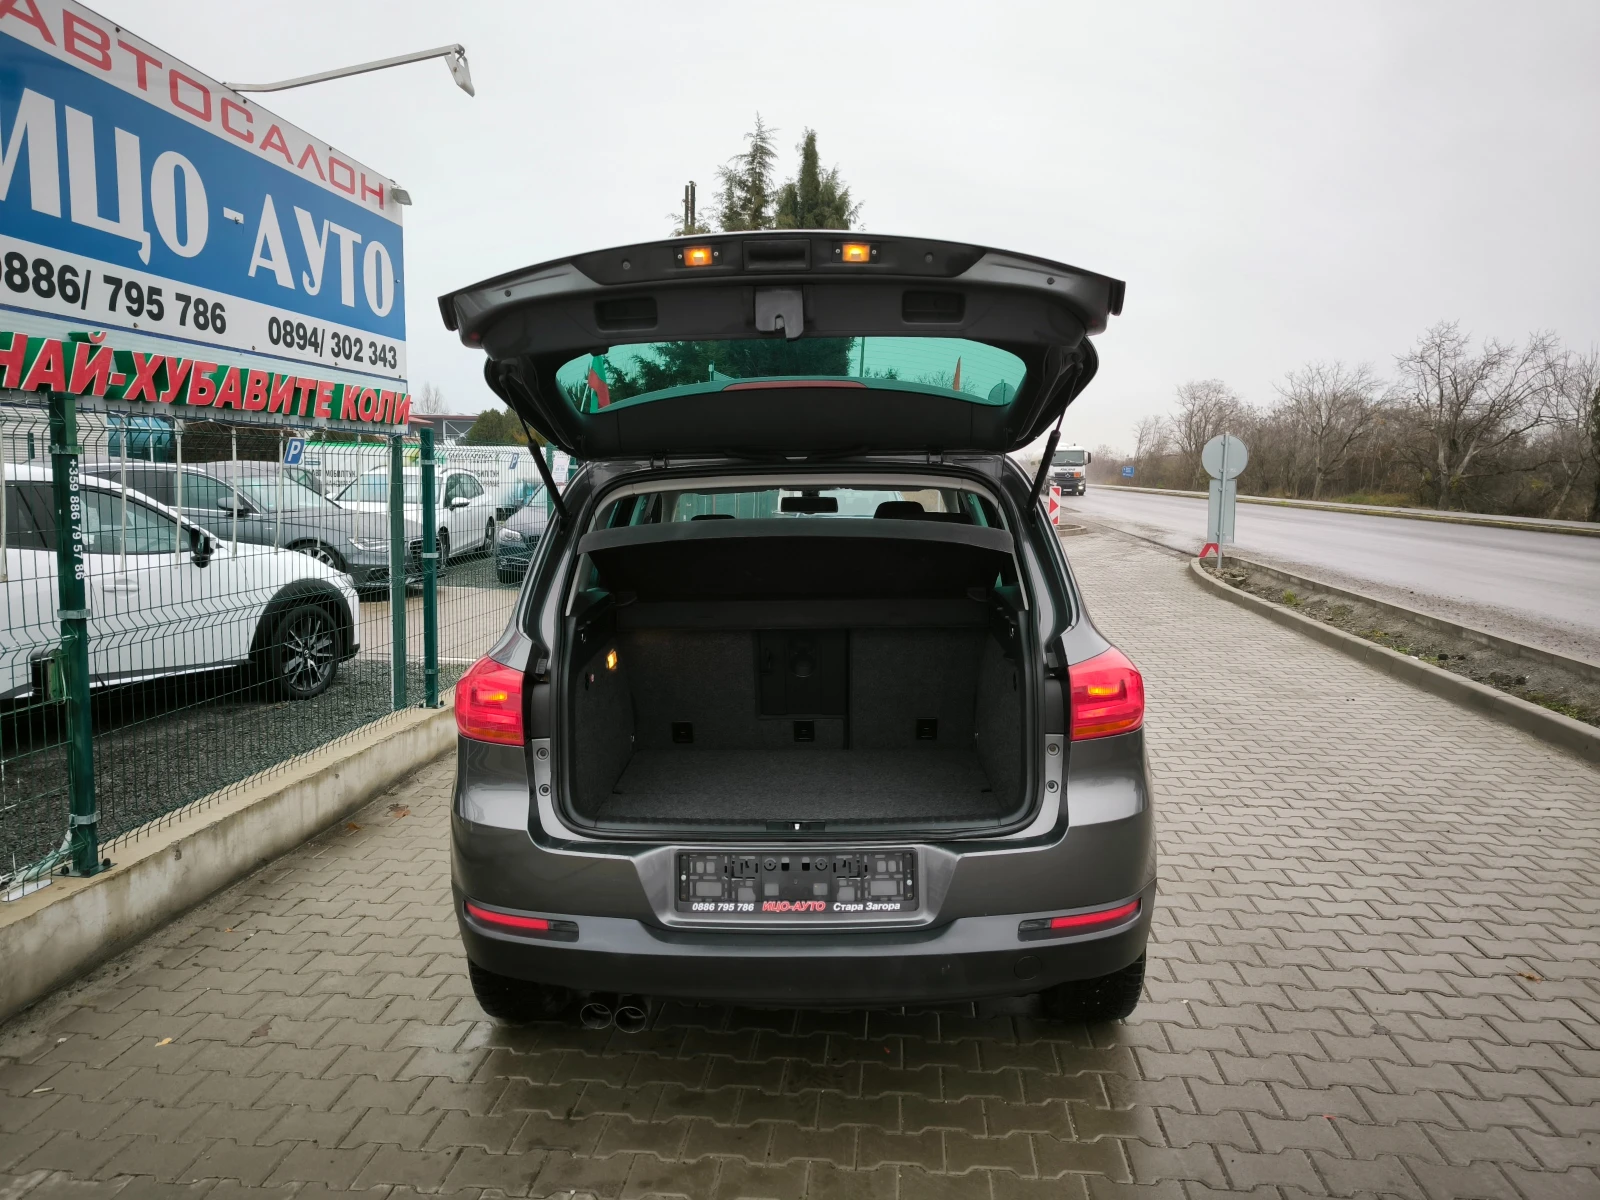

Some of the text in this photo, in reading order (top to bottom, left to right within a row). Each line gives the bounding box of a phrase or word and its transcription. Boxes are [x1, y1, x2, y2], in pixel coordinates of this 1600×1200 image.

[0, 0, 384, 210] АВТОСАЛОН
[0, 251, 227, 335] 886/ 795 786
[268, 316, 397, 370] 0894/ 302 343
[340, 383, 412, 426] КОЛИ
[69, 459, 84, 580] +359 886 79 57 86
[692, 901, 900, 912] 0886 795 786 ИЦО-АУТО Стара Загора
